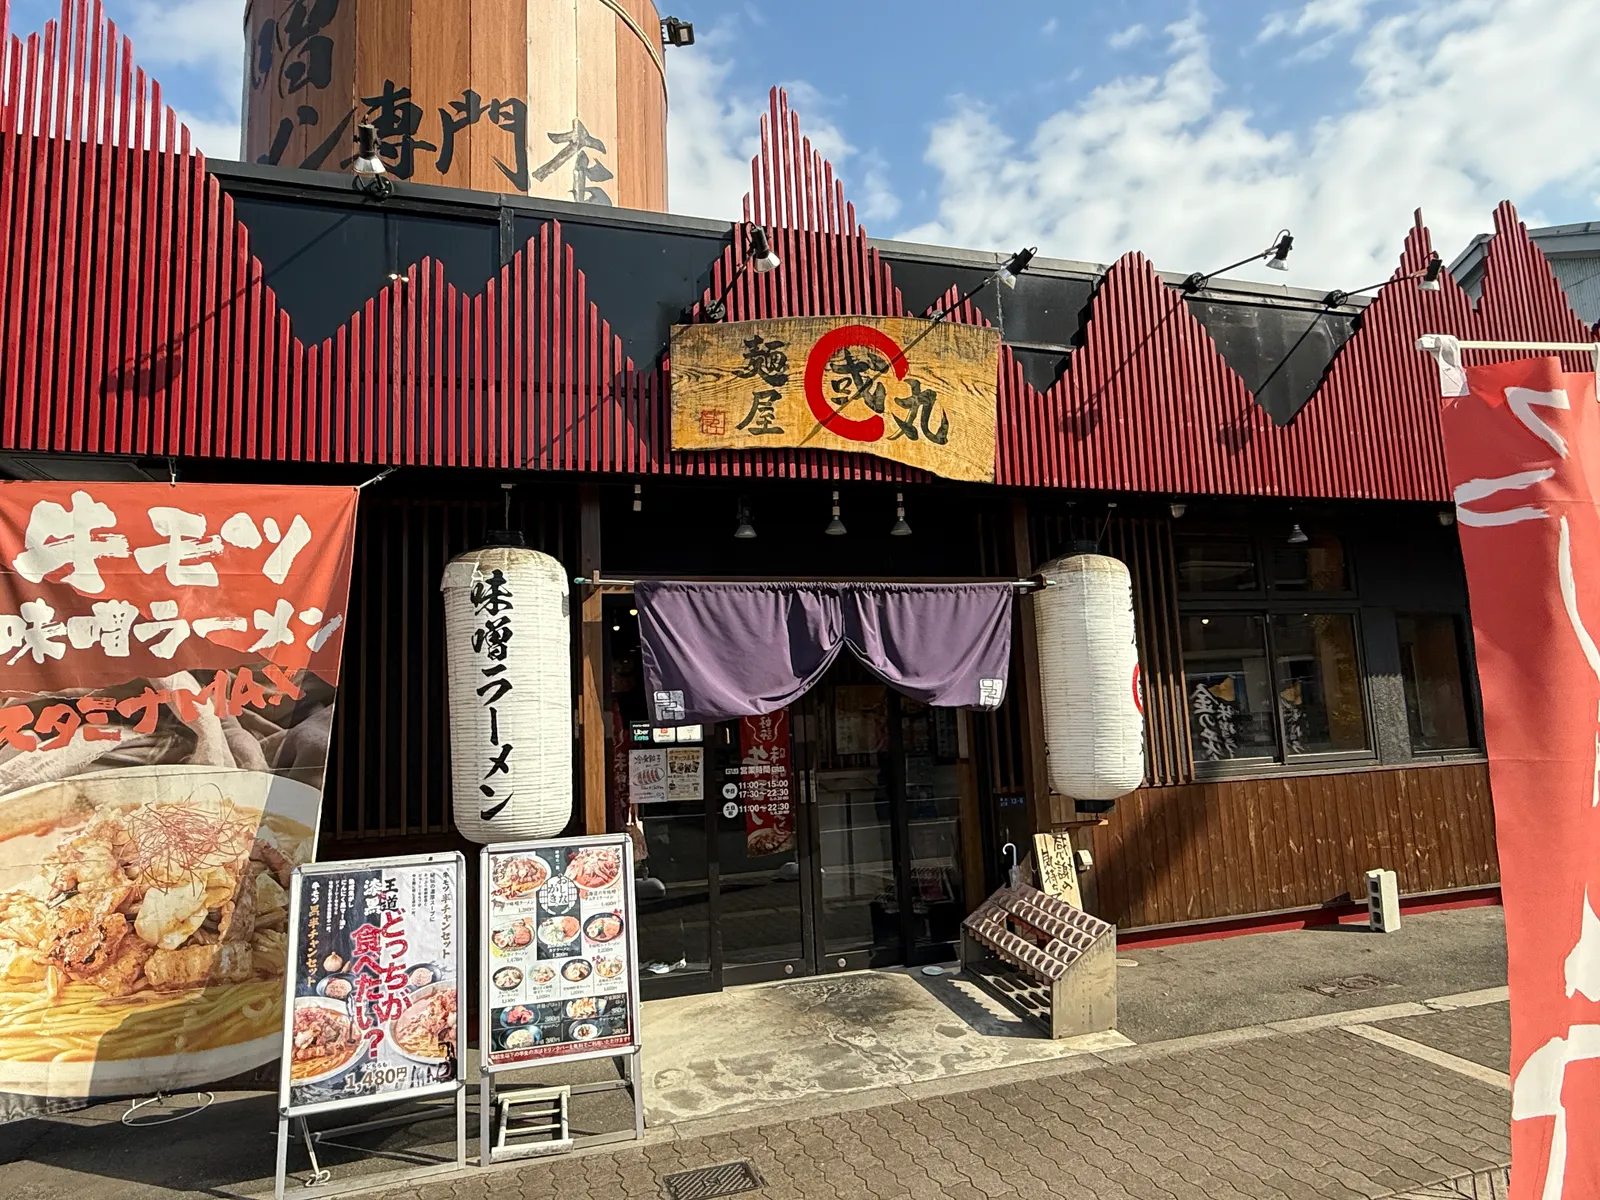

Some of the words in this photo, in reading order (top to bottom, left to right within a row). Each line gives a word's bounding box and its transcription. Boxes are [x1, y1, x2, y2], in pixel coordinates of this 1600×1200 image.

[731, 334, 789, 436] 麺屋
[12, 490, 312, 594] 牛モツ
[0, 598, 343, 666] 味噌ラーメン
[0, 687, 172, 752] スタミナ
[172, 664, 307, 723] MAX
[470, 569, 514, 821] 味噌ラーメン
[739, 780, 789, 790] 11:00〜15:00
[739, 788, 789, 799] 17:30〜22:30
[740, 766, 771, 775] 営業時間
[739, 803, 790, 813] 11:00〜22:30
[363, 877, 382, 916] 漆黒
[380, 877, 399, 912] 王道
[306, 881, 320, 987] 牛モツ黒半チャンセット
[373, 907, 413, 1025] どっちが
[351, 923, 388, 1058] 食べたい？
[346, 1066, 408, 1092] 1,480円
